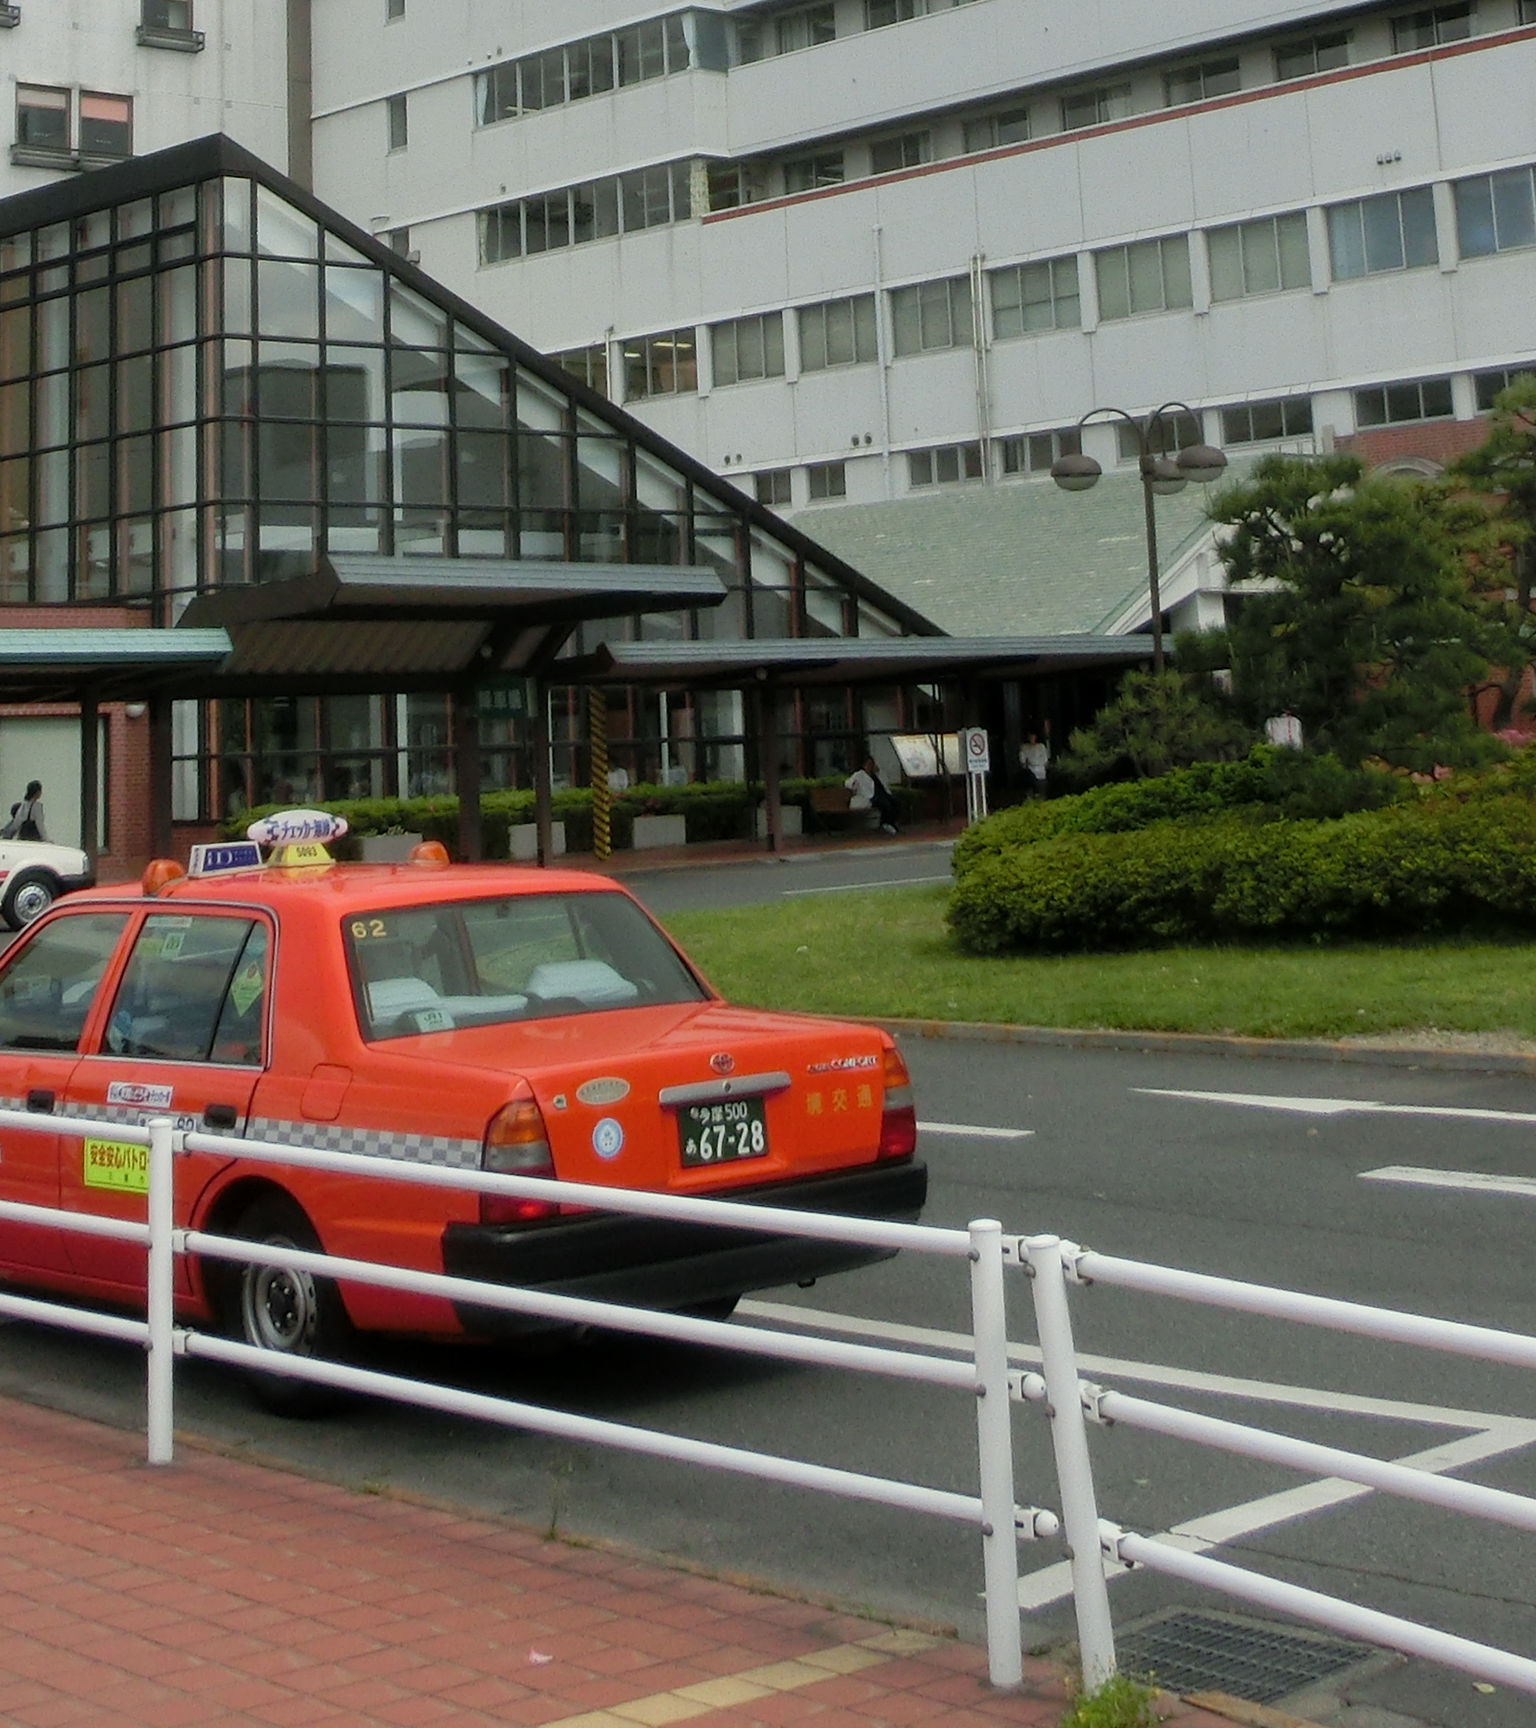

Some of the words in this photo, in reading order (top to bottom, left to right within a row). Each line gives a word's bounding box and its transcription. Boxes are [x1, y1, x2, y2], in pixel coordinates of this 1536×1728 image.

[206, 851, 233, 867] iD
[351, 919, 387, 939] 62
[699, 1105, 723, 1125] 多摩
[724, 1101, 748, 1121] 500
[685, 1137, 698, 1155] あ
[699, 1120, 765, 1160] 67-28
[90, 1143, 150, 1171] 安全安心パトロ
